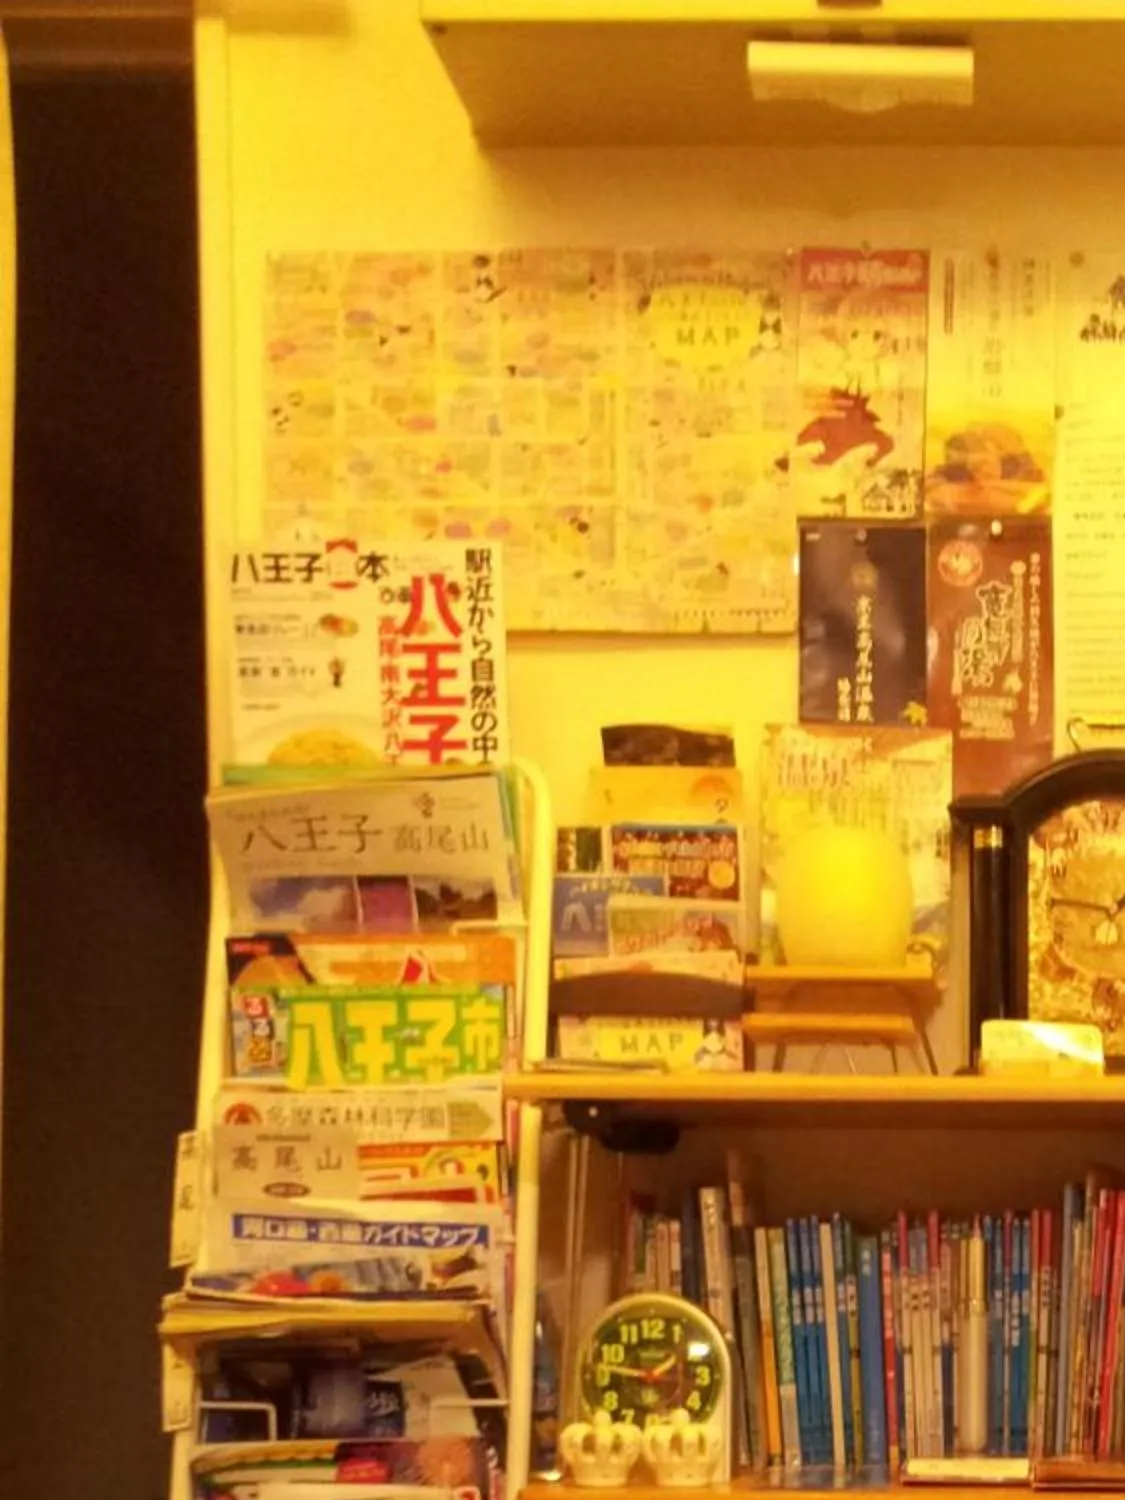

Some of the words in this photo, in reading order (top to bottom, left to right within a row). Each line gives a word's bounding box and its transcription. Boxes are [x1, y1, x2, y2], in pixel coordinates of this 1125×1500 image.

[231, 552, 325, 584] 八王子
[400, 573, 468, 765] 八王子
[243, 813, 384, 855] 八王子
[287, 999, 501, 1088] 八王子市
[231, 1145, 344, 1172] 高尾山
[640, 1318, 665, 1340] 12
[601, 1343, 625, 1363] 10
